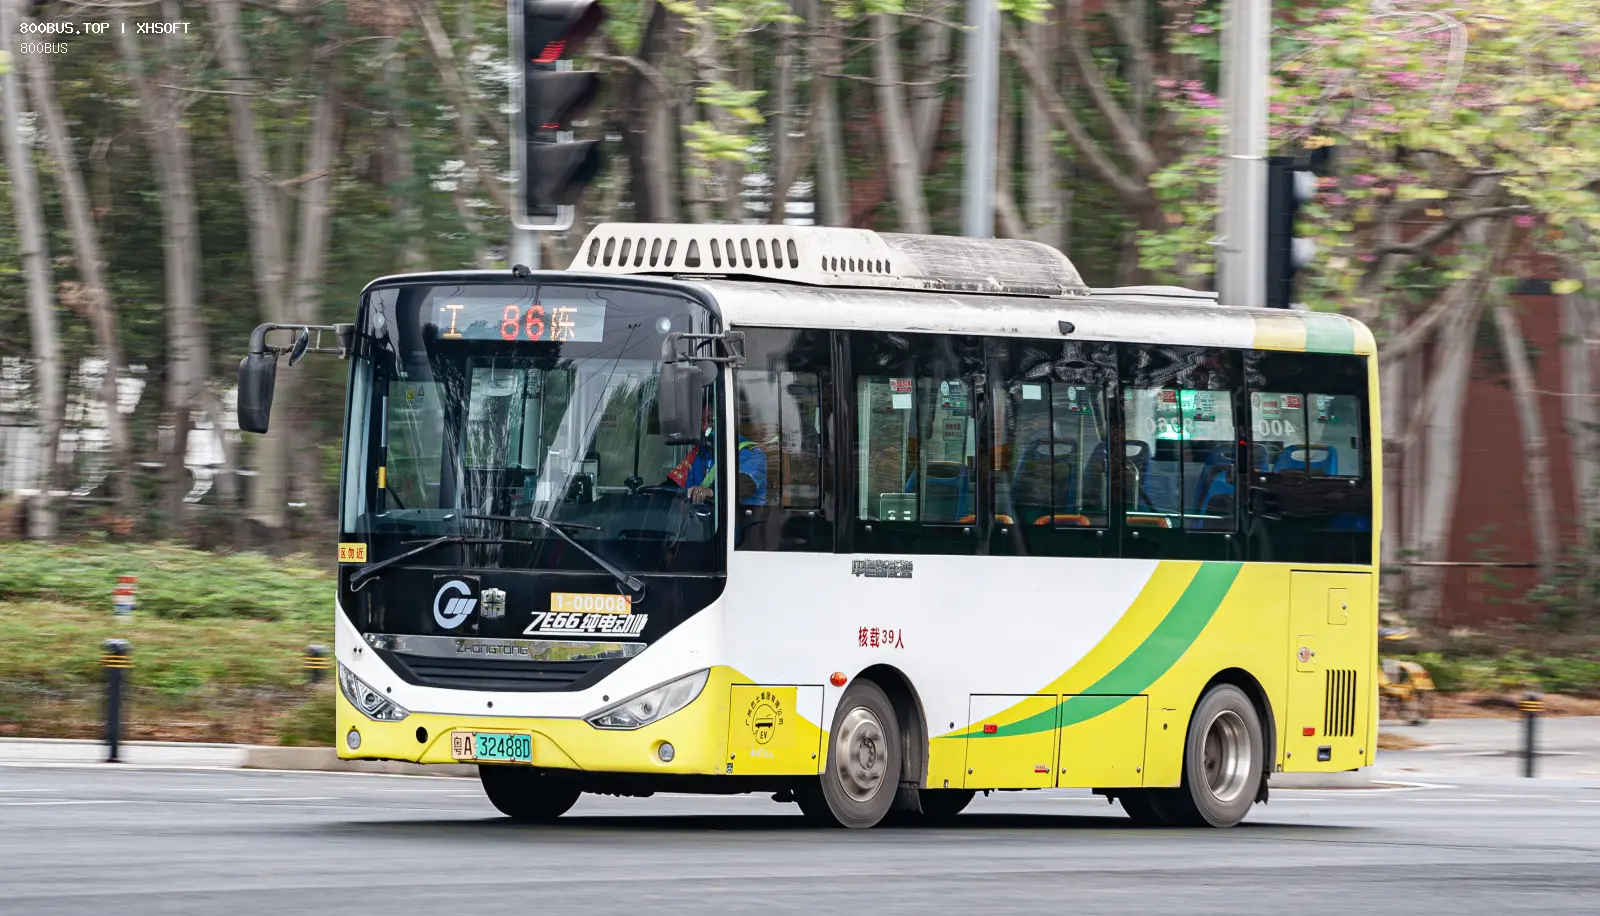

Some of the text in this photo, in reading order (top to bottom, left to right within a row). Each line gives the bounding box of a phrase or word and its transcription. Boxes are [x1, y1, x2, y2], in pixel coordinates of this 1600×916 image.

[501, 304, 545, 341] 86
[555, 595, 627, 613] 1-00008
[759, 730, 768, 740] EV
[479, 736, 530, 759] 32488D
